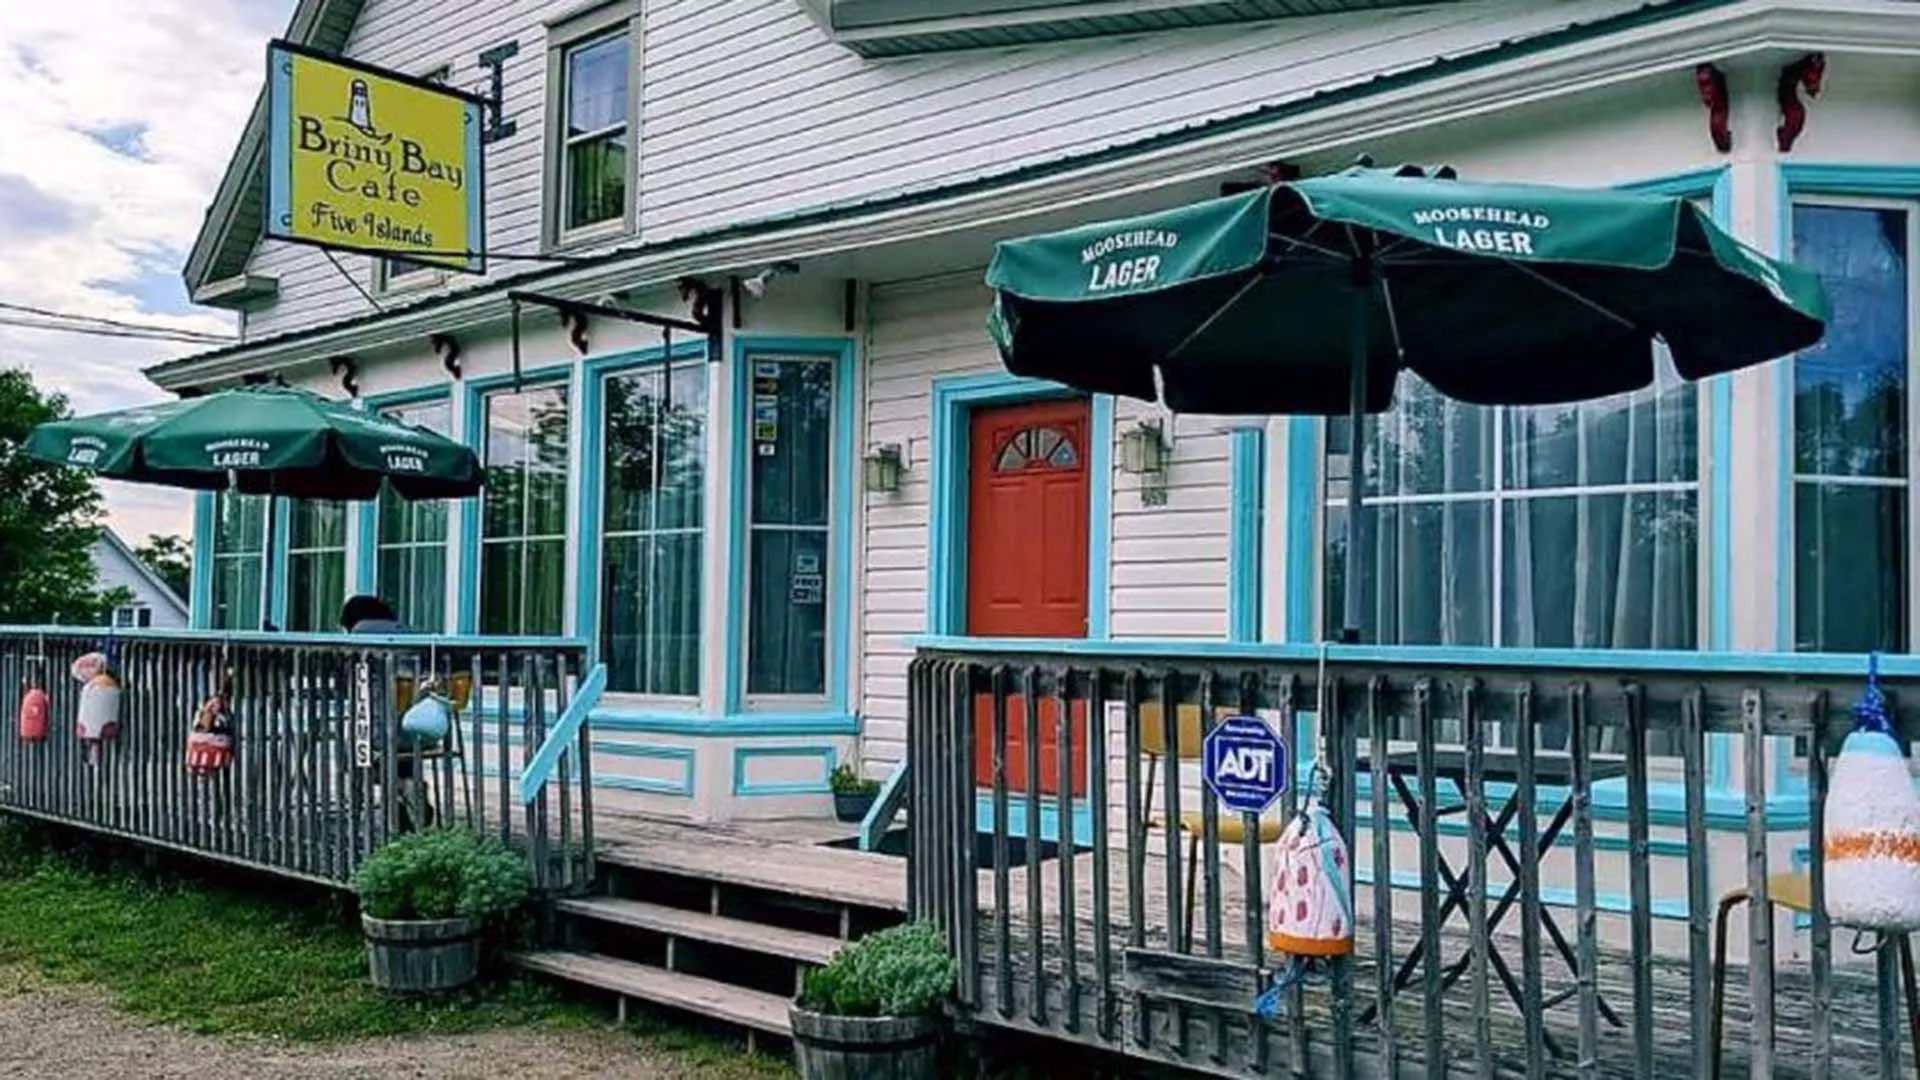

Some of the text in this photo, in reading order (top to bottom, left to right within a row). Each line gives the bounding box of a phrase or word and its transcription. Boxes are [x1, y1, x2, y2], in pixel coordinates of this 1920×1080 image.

[298, 115, 463, 190] Briny Bay
[326, 158, 422, 208] Cafe
[311, 202, 433, 247] Five Islands
[1412, 207, 1550, 229] MOOSEHEAD
[1081, 230, 1178, 264] MOOSEHEAD
[1434, 226, 1534, 255] LAGER
[1088, 255, 1161, 291] LAGER
[213, 451, 260, 466] LAGER
[387, 454, 424, 472] LAGER
[1215, 746, 1274, 782] ADT
